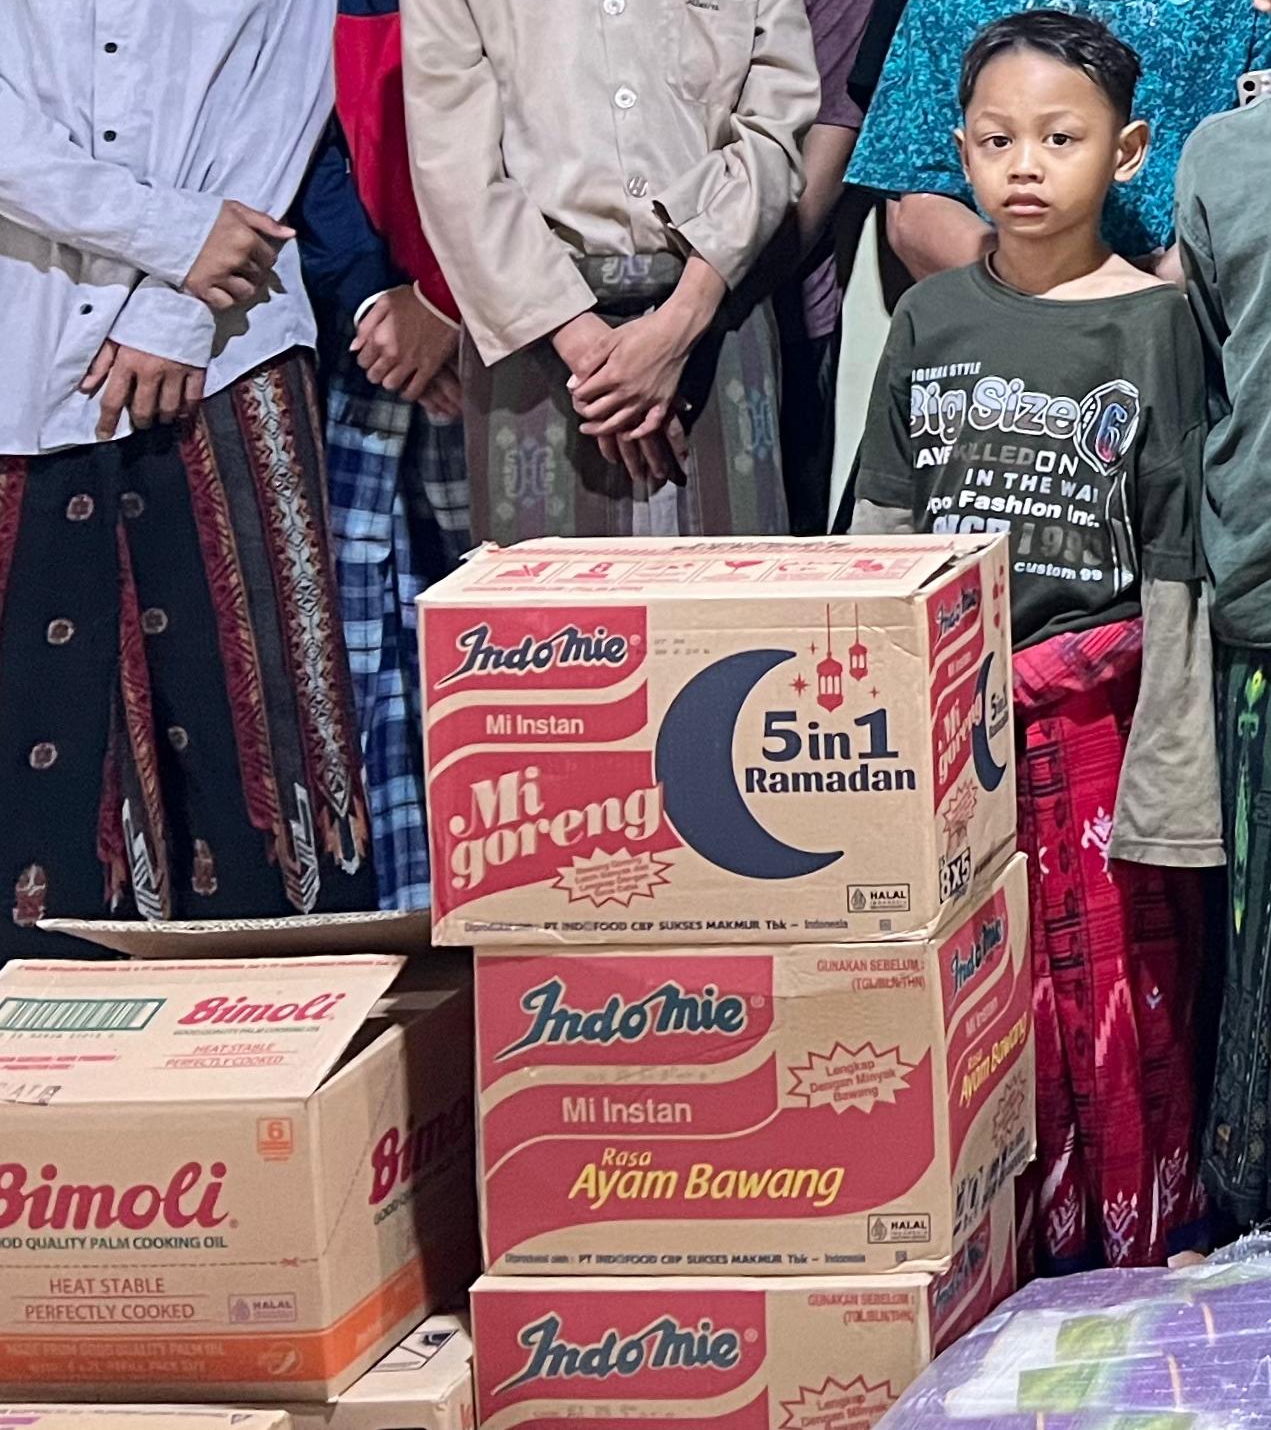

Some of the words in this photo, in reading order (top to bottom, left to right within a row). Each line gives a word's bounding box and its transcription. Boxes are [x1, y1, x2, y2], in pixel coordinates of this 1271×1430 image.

[968, 375, 1081, 439] Size
[964, 468, 994, 487] IN
[1003, 473, 1053, 494] THE
[959, 490, 1063, 519] Fashion
[1014, 561, 1077, 581] custom
[486, 715, 511, 734] Mi
[516, 715, 584, 734] Instan
[745, 764, 916, 793] Ramadan
[449, 766, 545, 837] Mi
[451, 782, 664, 890] goreng
[870, 890, 907, 900] HALAL
[706, 920, 760, 931] MAKMUR
[817, 959, 867, 971] GUNAKAN
[870, 959, 918, 971] SEBELUM
[177, 992, 347, 1026] Bimoli
[562, 1097, 596, 1123] Mi
[603, 1097, 692, 1123] Instan
[267, 1122, 283, 1140] 6
[602, 1147, 652, 1167] Rasa
[0, 1161, 229, 1230] Bimoli
[569, 1165, 678, 1210] Ayam
[685, 1164, 845, 1207] Bawang
[891, 1221, 927, 1230] HALAL
[26, 1236, 86, 1251] QUALITY
[90, 1236, 130, 1250] PALM
[133, 1236, 200, 1249] COOKING
[204, 1236, 228, 1249] OIL
[50, 1278, 95, 1294] HEAT
[101, 1278, 165, 1293] STABLE
[25, 1304, 117, 1320] PERFECTLY
[121, 1304, 195, 1319] COOKED
[253, 1301, 292, 1310] HALAL
